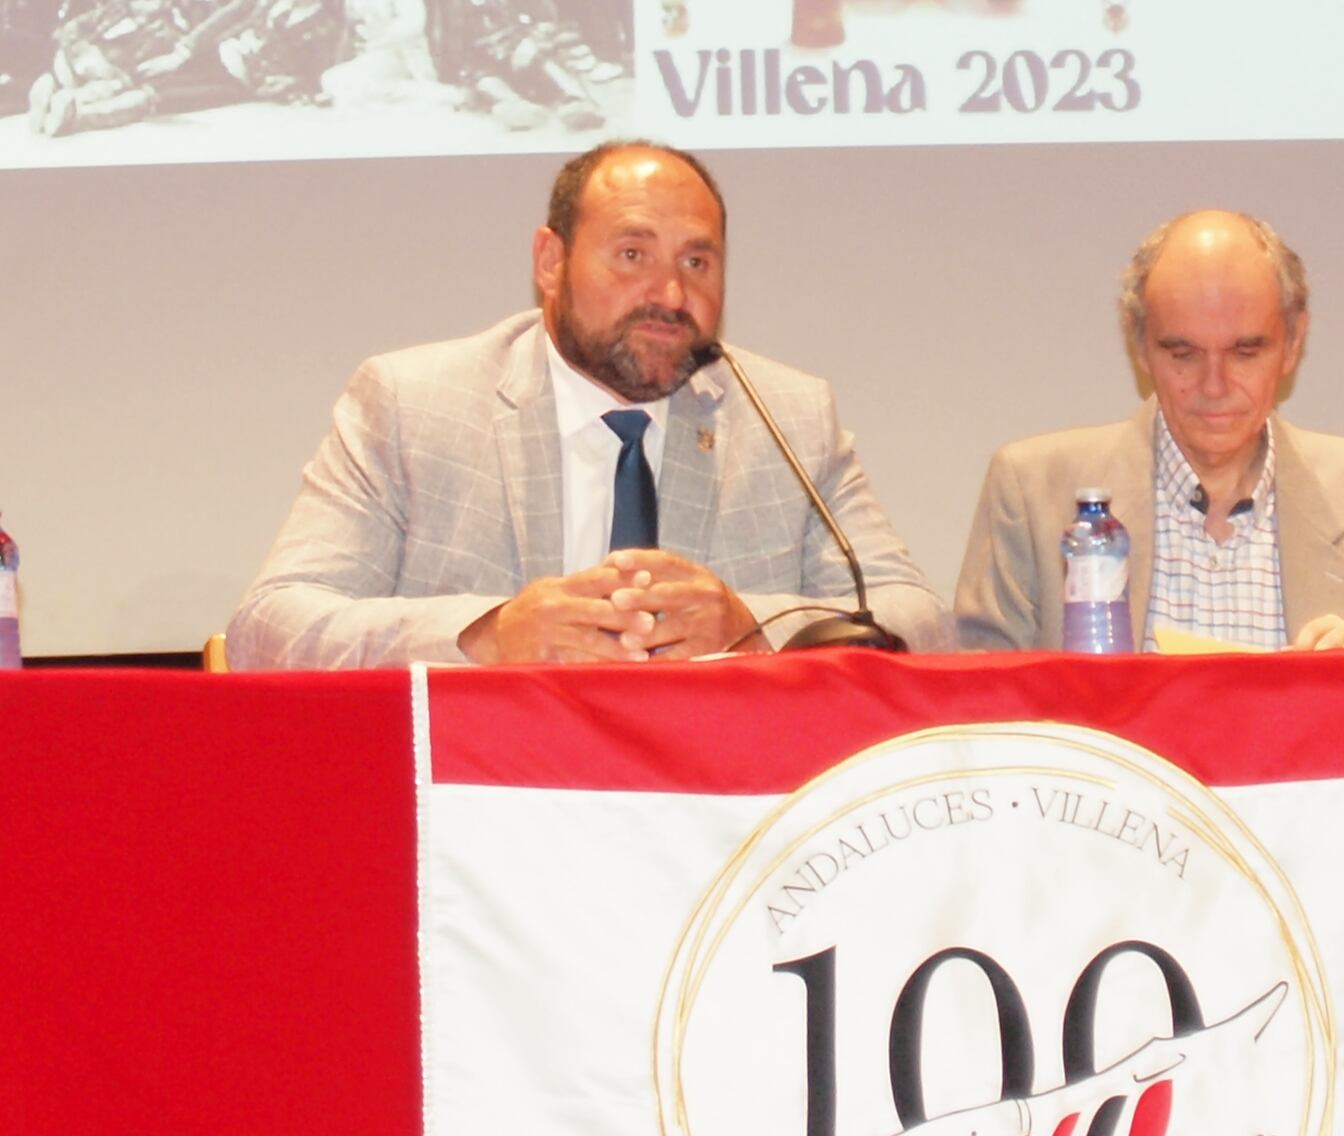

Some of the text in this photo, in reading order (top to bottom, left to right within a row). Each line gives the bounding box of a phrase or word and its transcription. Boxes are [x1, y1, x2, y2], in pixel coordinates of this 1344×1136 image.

[652, 47, 1143, 118] Villena 2023
[765, 786, 1195, 936] ANDALUCES VILLENA
[771, 939, 1206, 1136] 100
